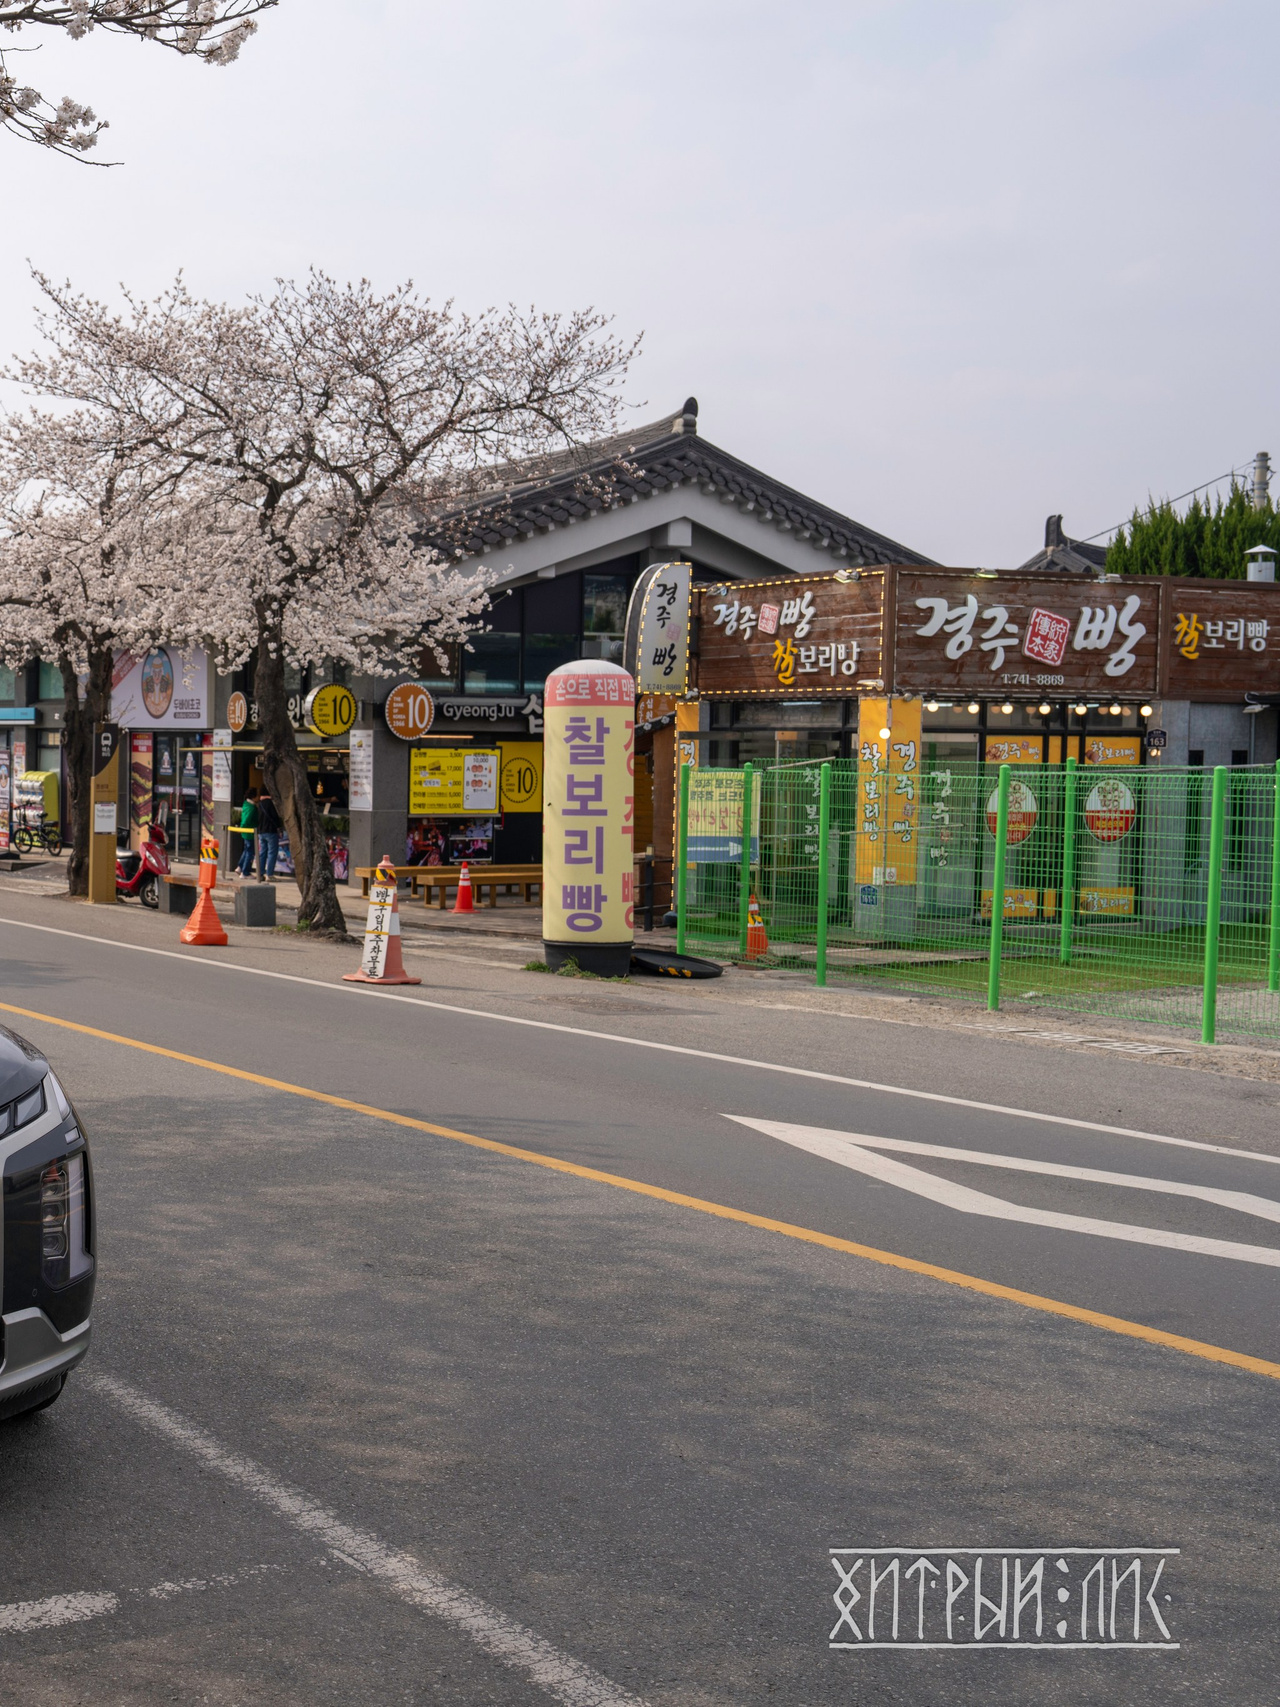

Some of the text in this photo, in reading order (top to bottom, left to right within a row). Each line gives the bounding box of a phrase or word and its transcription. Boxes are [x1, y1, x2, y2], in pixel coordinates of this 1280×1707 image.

[713, 600, 758, 640] 경주
[780, 591, 816, 638] 빵
[915, 594, 1146, 677] 경주 빵
[1174, 613, 1270, 660] 찰보리빵
[555, 679, 591, 700] 손으로
[595, 678, 618, 700] 직접
[173, 699, 200, 710] 두바이초코
[236, 699, 245, 724] 10
[332, 695, 351, 725] 10
[407, 694, 429, 728] 10
[443, 703, 515, 721] GyeongJu
[995, 742, 1040, 761] 경주 빵
[1091, 741, 1136, 762] 찰보리빵
[1150, 737, 1164, 746] 163
[517, 767, 533, 794] 10
[893, 740, 916, 800] 경주
[562, 716, 610, 933] 찰보리빵
